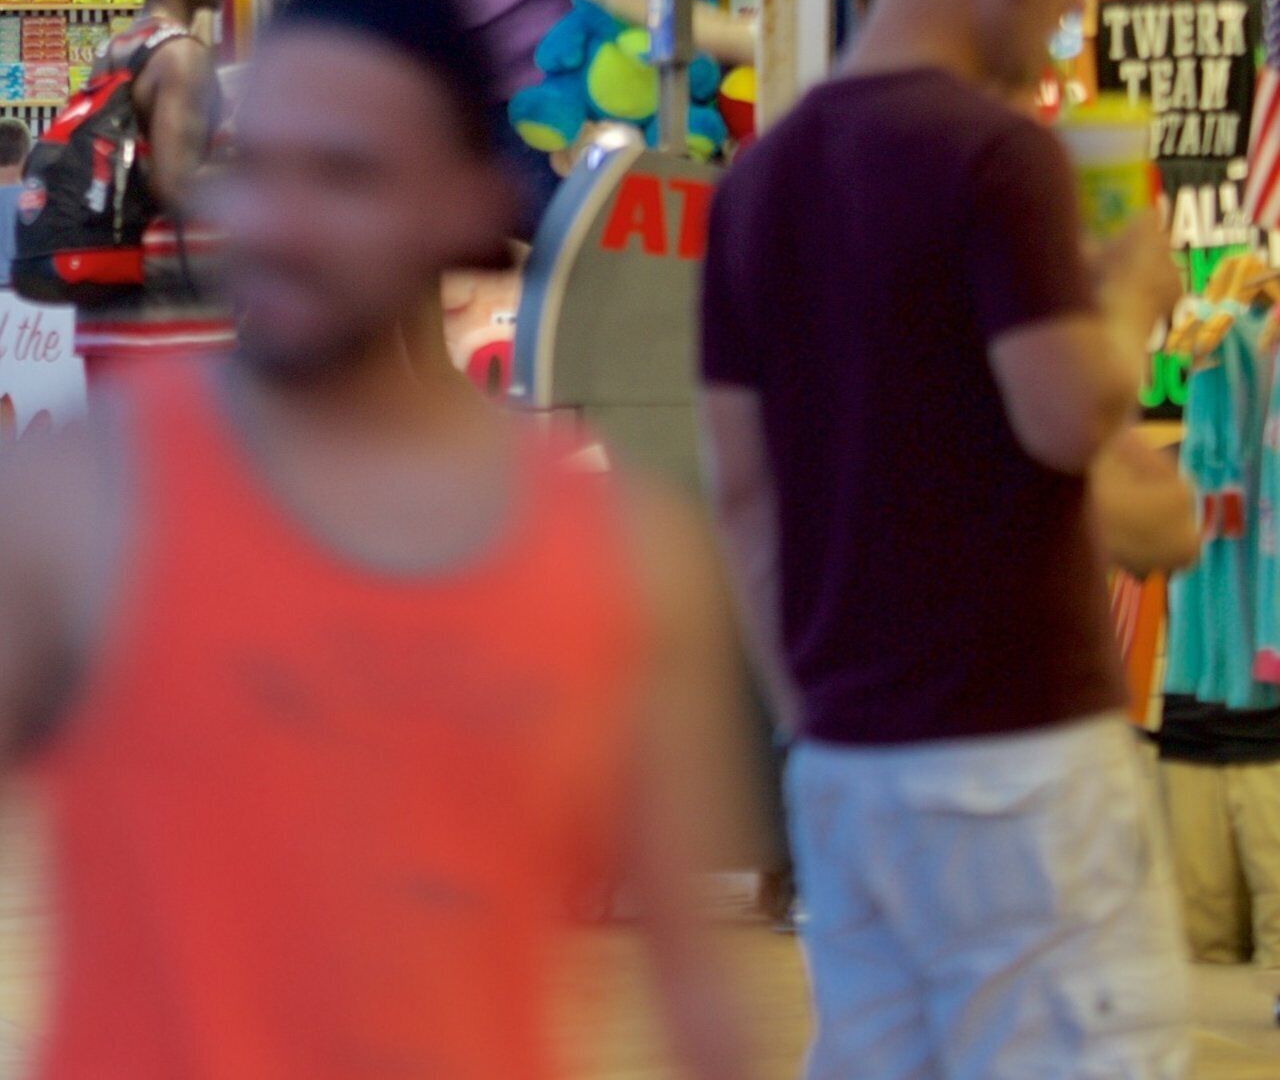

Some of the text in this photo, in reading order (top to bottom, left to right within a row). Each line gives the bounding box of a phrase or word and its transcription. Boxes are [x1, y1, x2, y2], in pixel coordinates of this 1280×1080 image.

[1102, 0, 1248, 60] TWERK
[1119, 57, 1232, 112] TEAM
[14, 312, 62, 363] the
